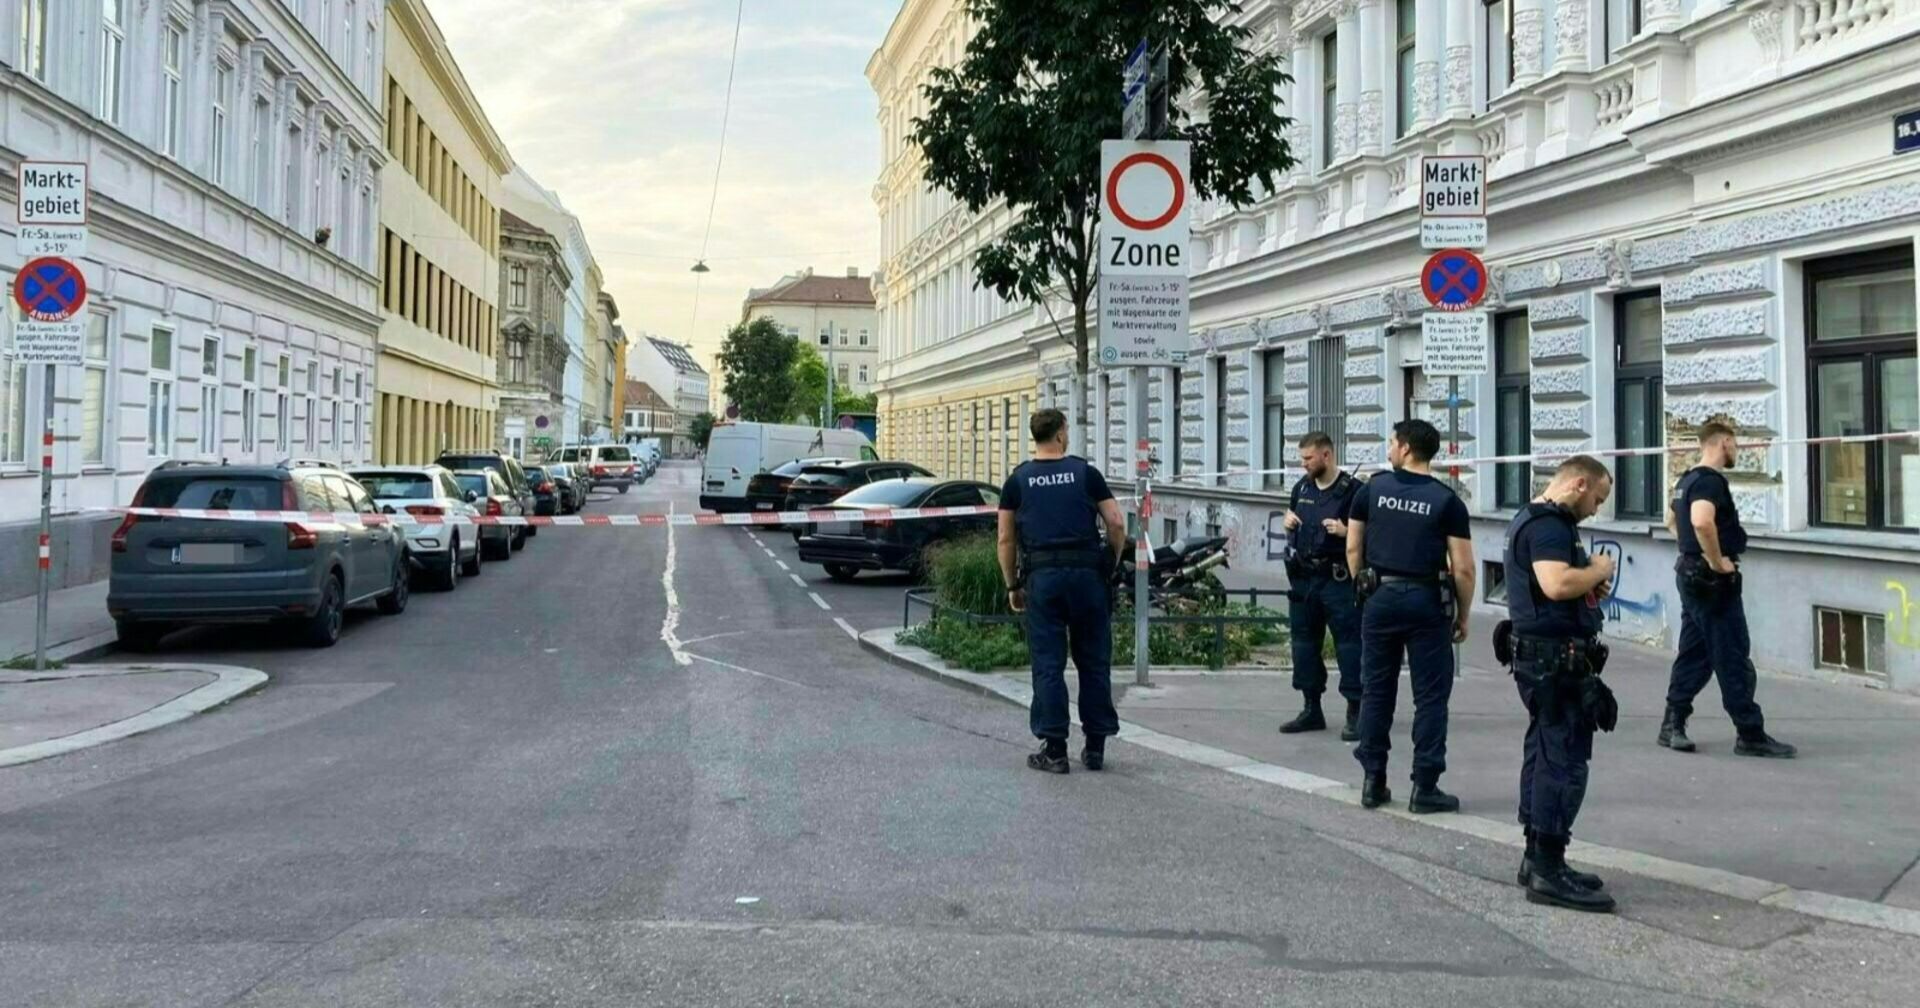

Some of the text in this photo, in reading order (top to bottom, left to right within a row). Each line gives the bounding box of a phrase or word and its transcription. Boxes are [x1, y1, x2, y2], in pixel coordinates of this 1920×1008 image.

[24, 169, 81, 188] Markt-
[1425, 161, 1482, 183] Markt-
[1425, 186, 1479, 211] gebiet
[24, 195, 81, 217] gebiet
[1110, 237, 1180, 266] Zone
[1141, 295, 1180, 306] Fahrzeuge
[1437, 300, 1473, 311] ANFANG
[29, 308, 70, 321] ANFANG
[1107, 307, 1181, 318] mit Wagenkarte der
[1111, 320, 1177, 332] Marktverwaltung
[1133, 336, 1155, 344] sowie
[1452, 344, 1484, 352] Fahrzeuge
[1441, 354, 1483, 362] Wagenkarten
[1028, 472, 1075, 487] POLIZEI
[1377, 495, 1432, 516] POLIZEI
